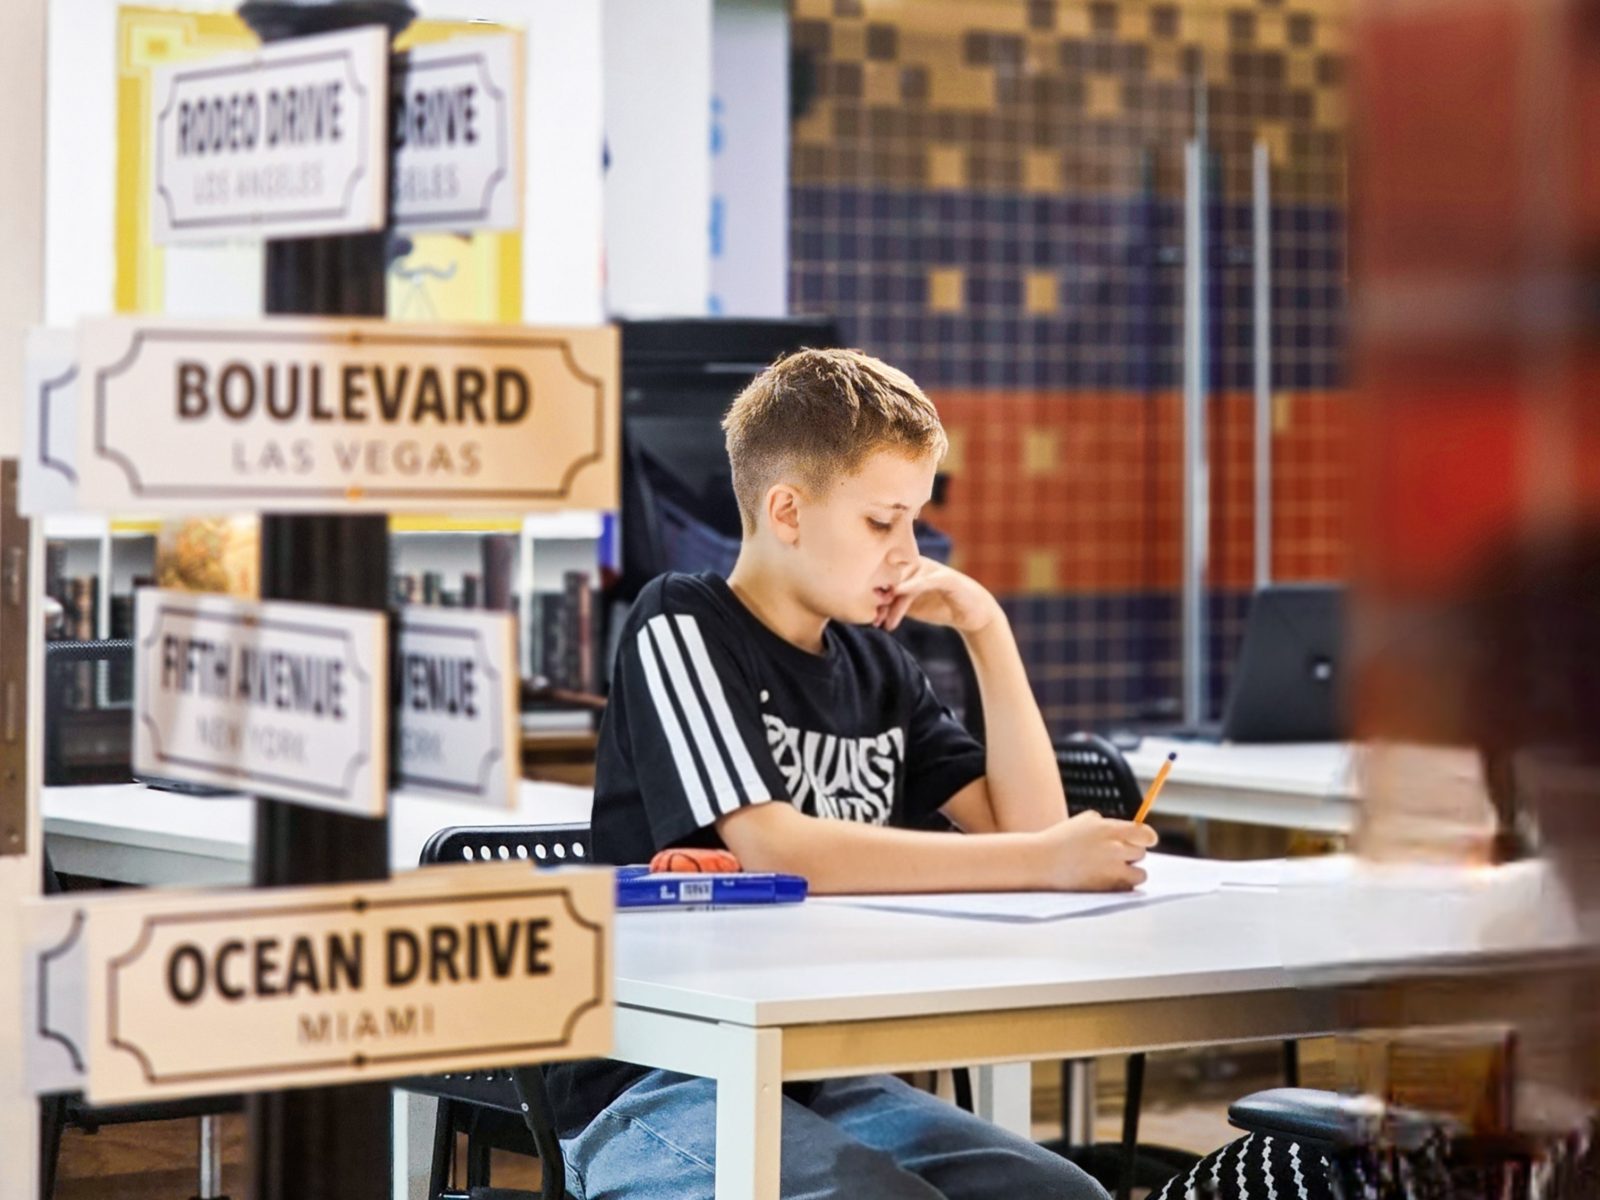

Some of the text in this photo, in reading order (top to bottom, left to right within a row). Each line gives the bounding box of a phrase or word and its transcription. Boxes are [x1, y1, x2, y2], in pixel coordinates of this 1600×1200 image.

[177, 80, 344, 156] RODEO DRIVE
[193, 159, 325, 205] LOS ANGELES
[176, 361, 532, 425] BOULEVARD
[232, 440, 482, 476] LAS VEGAS
[161, 634, 347, 720] FIFTH AVENUE
[166, 918, 553, 1005] OCEAN DRIVE
[297, 1005, 437, 1046] MIAMI
